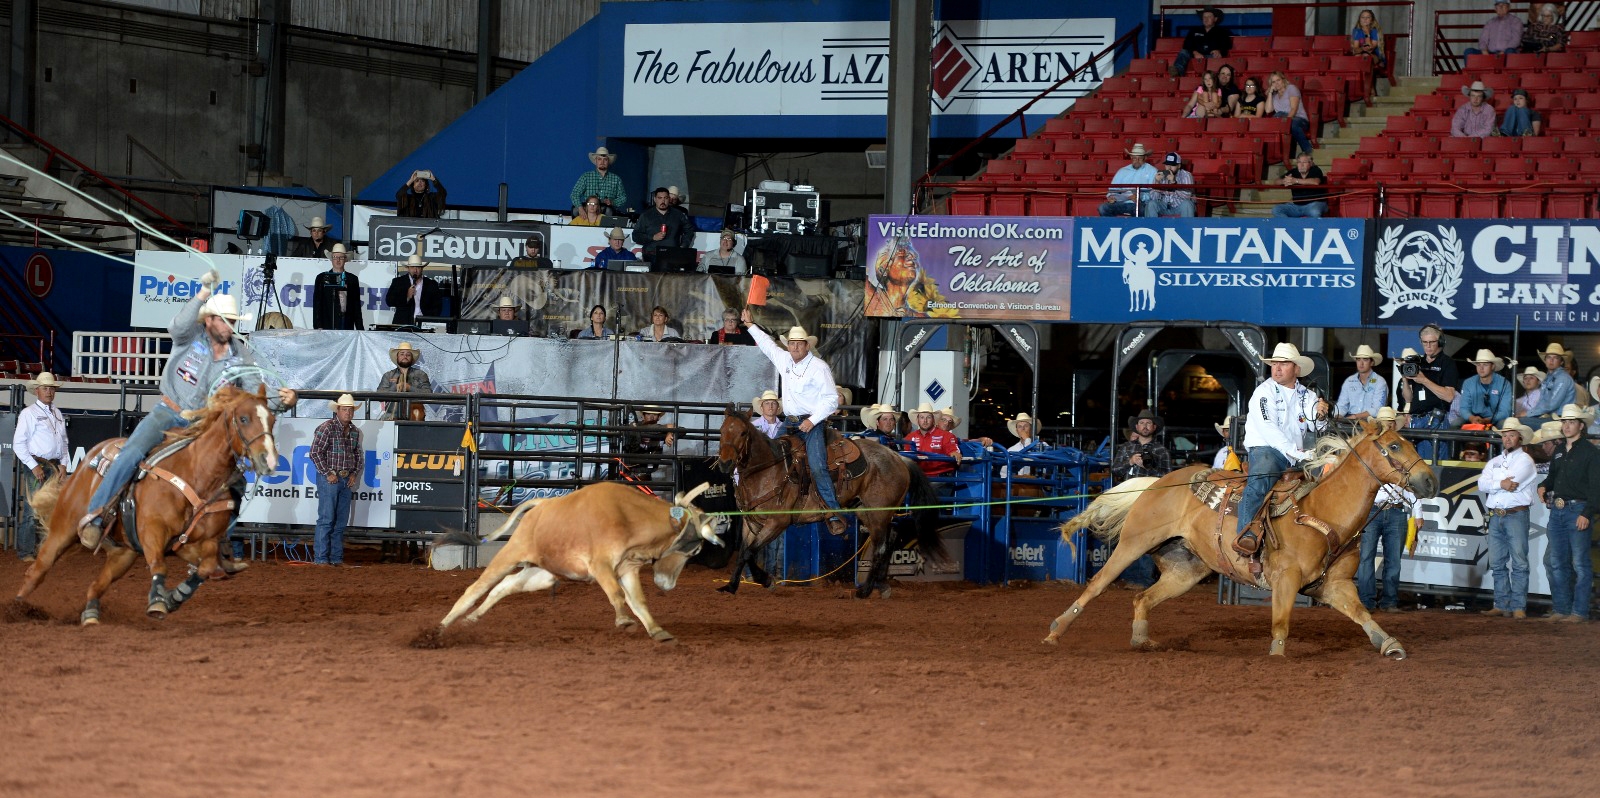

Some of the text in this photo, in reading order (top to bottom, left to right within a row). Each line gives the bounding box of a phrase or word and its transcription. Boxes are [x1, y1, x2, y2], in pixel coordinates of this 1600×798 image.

[633, 48, 680, 84] The
[686, 47, 817, 84] Fabulous
[821, 53, 889, 85] LAZ
[981, 51, 1102, 83] ARENA
[878, 221, 1063, 240] VisitEdmondOK.com
[424, 235, 531, 262] EQUIN
[1079, 226, 1355, 265] MONTANA
[948, 245, 1048, 273] The Art of
[34, 264, 45, 287] L
[949, 271, 1042, 294] Oklahoma
[1158, 272, 1356, 288] SILVERSMITHS
[280, 283, 391, 311] CIH
[927, 301, 956, 309] Edmond
[958, 302, 998, 310] Convention
[1007, 302, 1034, 310] Visitors
[1035, 303, 1061, 311] Bureau
[1397, 292, 1439, 305] CINCH
[1472, 283, 1581, 310] JEANS
[254, 485, 383, 502] Ranch Ement
